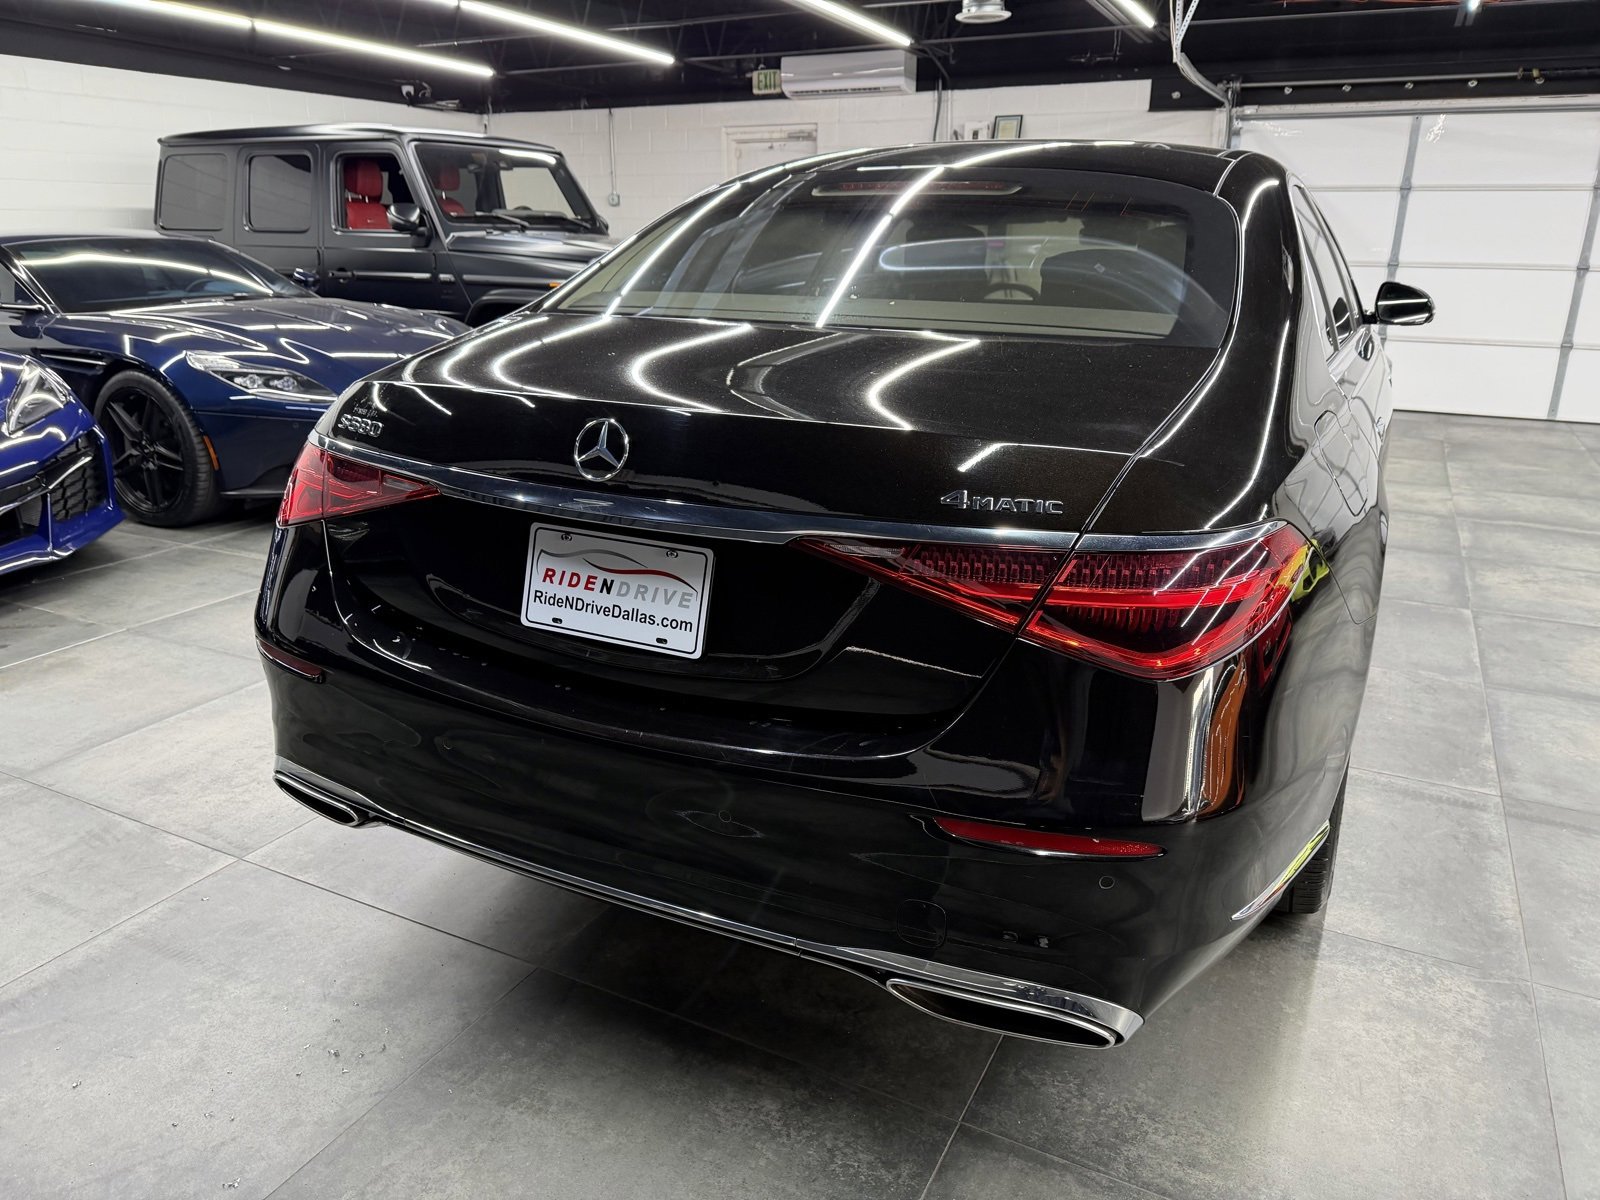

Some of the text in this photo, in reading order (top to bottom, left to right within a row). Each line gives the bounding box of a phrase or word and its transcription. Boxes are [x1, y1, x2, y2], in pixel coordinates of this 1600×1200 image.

[757, 71, 777, 91] EXIT
[940, 489, 1064, 514] 4MATIC
[542, 567, 693, 609] RIDENDRIVE
[533, 589, 693, 632] RideNDriveDallas.com
